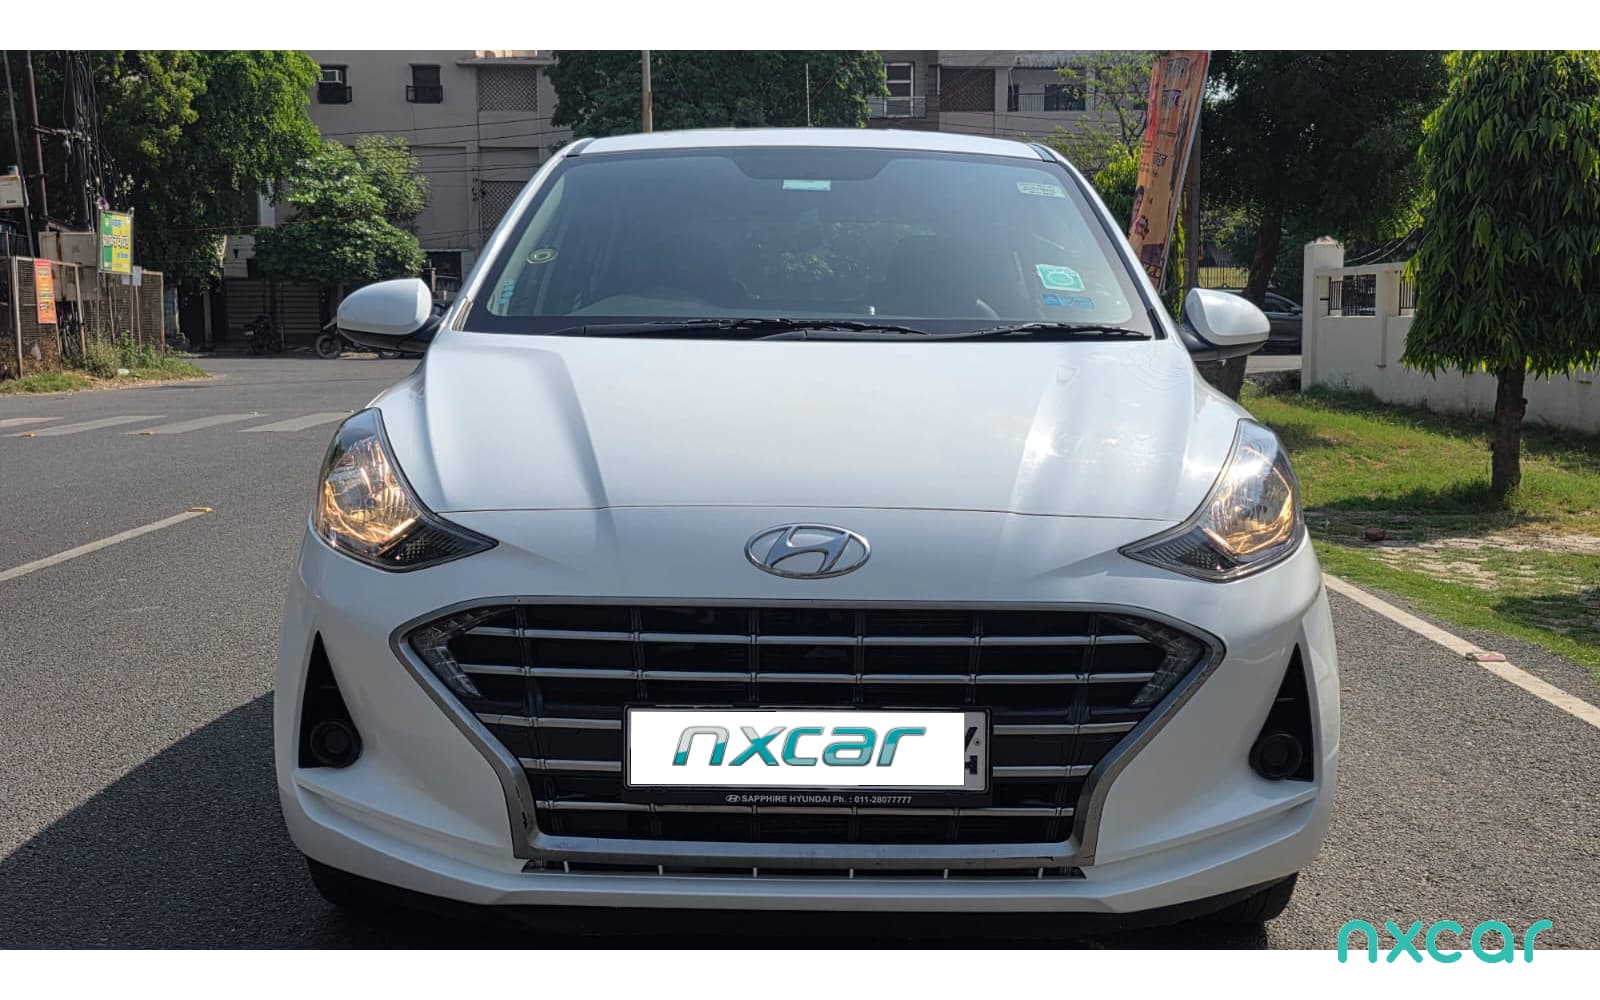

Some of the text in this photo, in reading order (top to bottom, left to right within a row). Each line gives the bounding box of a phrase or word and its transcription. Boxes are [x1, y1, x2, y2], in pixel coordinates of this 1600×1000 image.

[742, 795, 788, 803] SAPPHIRE
[790, 795, 831, 803] HYUNDAI
[854, 796, 912, 804] 011-28077777
